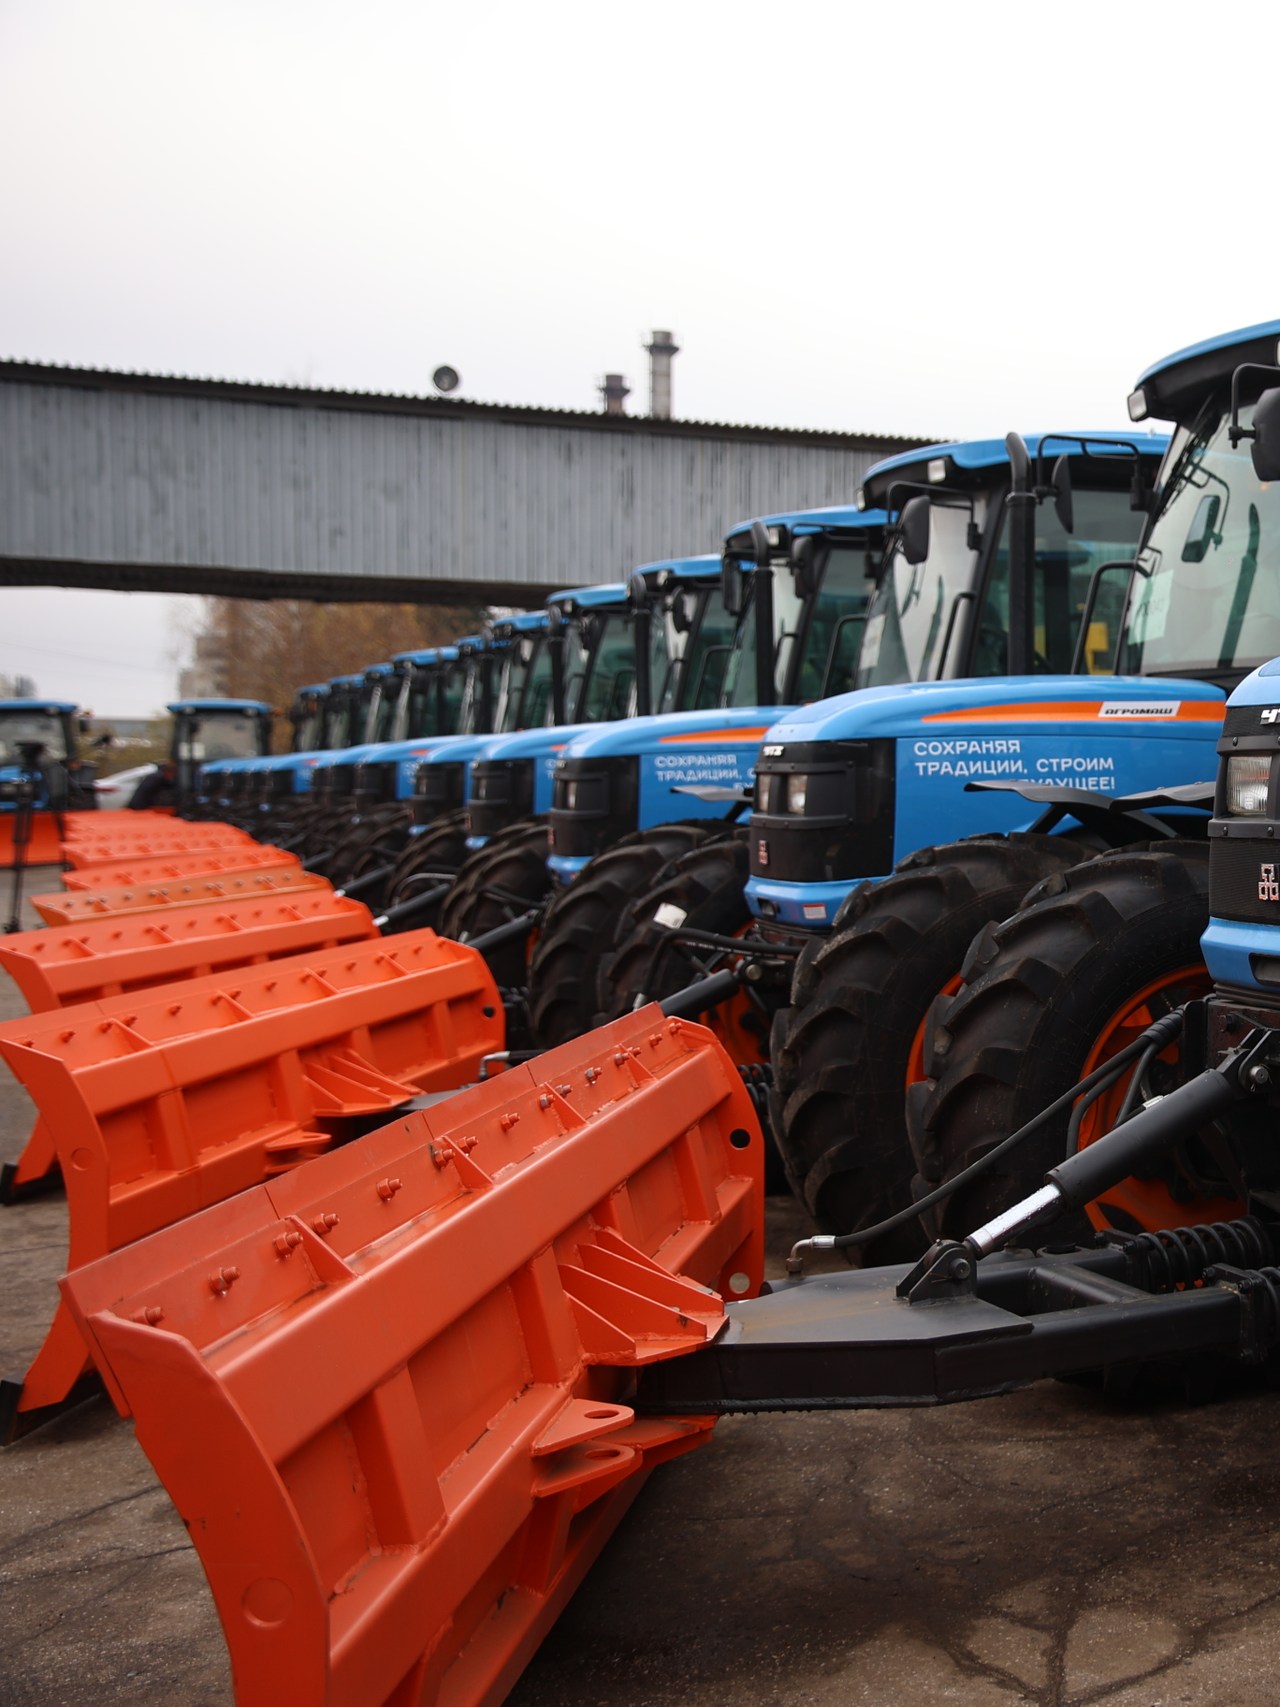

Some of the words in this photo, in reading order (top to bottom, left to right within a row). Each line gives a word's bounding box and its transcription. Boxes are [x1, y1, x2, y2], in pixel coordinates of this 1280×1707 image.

[1104, 707, 1173, 715] АГРОМАШ
[913, 740, 1021, 756] СОХРАНЯЯ
[654, 754, 737, 768] СОХРАНЯЯ
[915, 760, 1028, 777] ТРАДИЦИИ,
[1036, 757, 1114, 773] СТРОИМ
